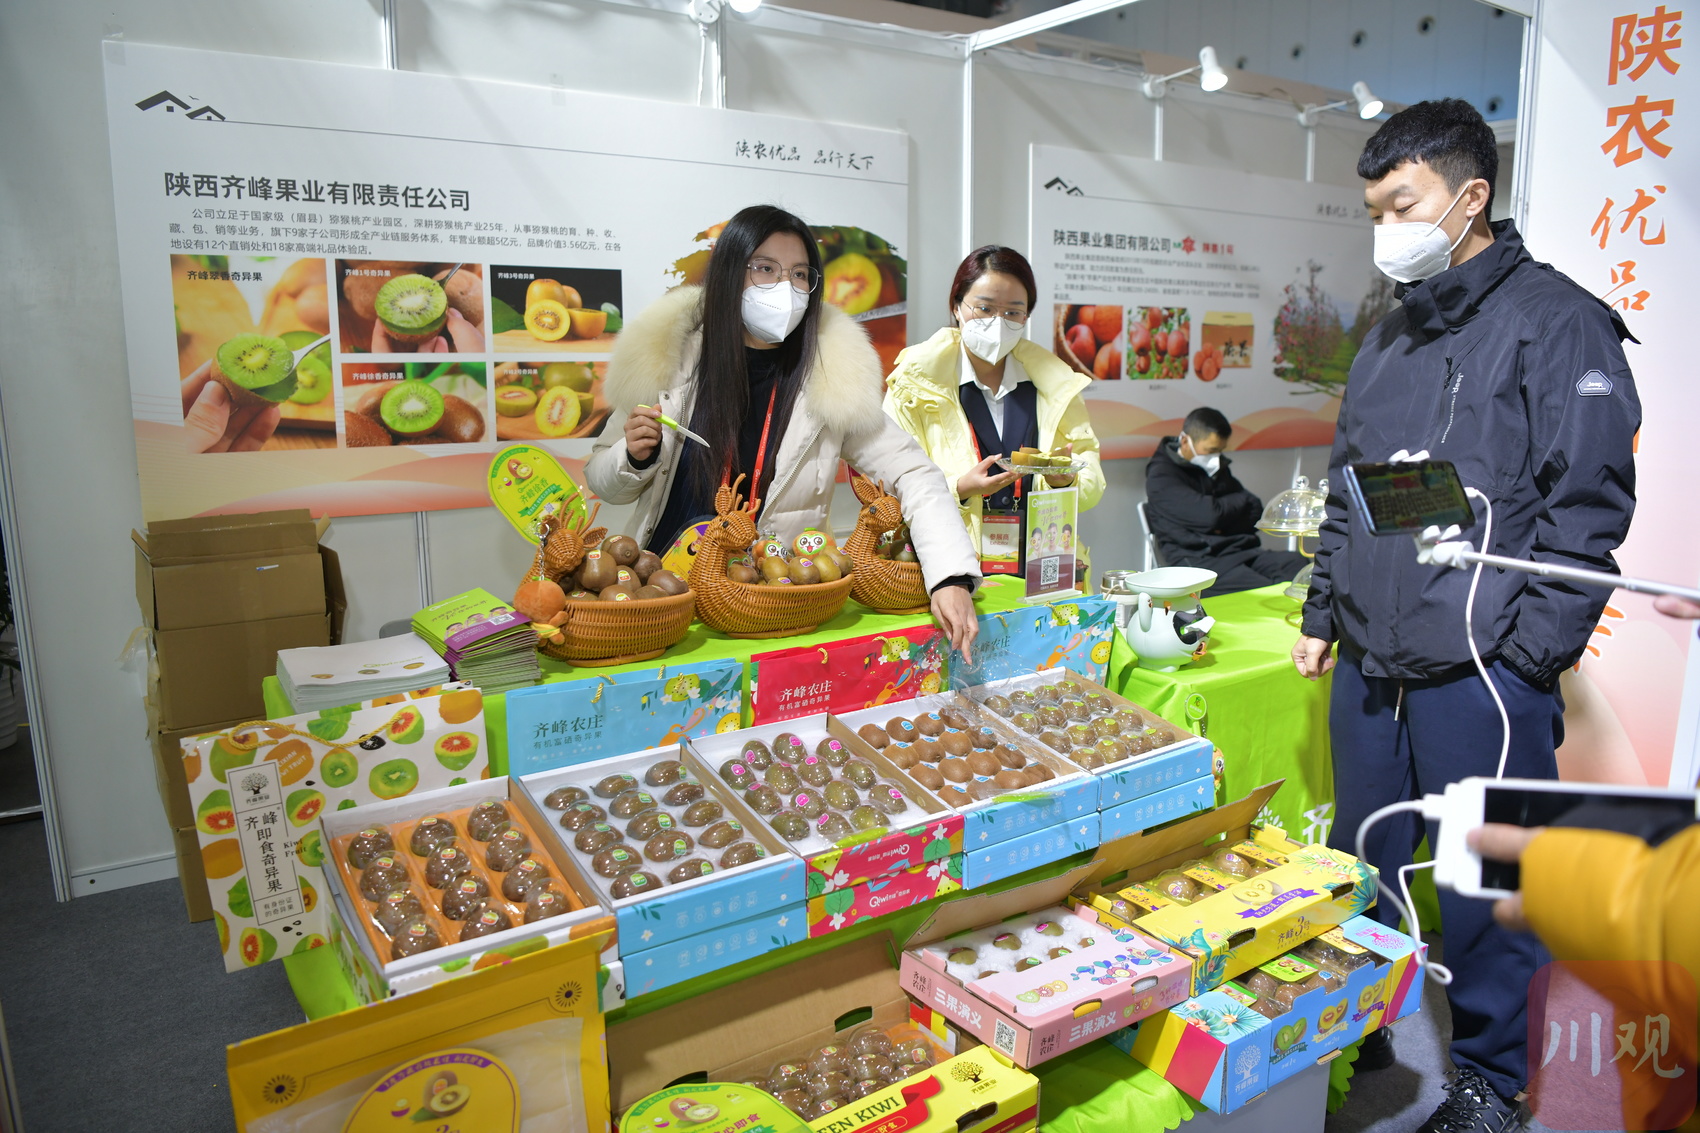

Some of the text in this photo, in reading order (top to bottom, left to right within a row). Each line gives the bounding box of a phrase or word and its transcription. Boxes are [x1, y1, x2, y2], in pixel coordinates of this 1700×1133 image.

[1591, 5, 1682, 311] 陕农优品
[163, 171, 471, 211] 陕西齐峰果业有限责任公司
[1053, 229, 1172, 253] 陕西果业集团有限公司
[187, 270, 263, 282] 齐峰翠香奇异果
[345, 268, 391, 277] 齐峰1号奇异果
[352, 371, 404, 381] 齐峰徐香奇异果
[1452, 372, 1465, 394] Jeep
[1587, 381, 1603, 389] Jeep
[989, 533, 1010, 541] 参展商
[780, 680, 832, 702] 齐峰农庄
[533, 714, 603, 739] 齐峰农庄
[533, 731, 602, 749] 有机富硒奇异果
[283, 838, 303, 849] Kiwi
[284, 846, 307, 857] Fruit
[934, 987, 982, 1029] 三果演义
[1068, 1011, 1117, 1042] 三果演义
[857, 1096, 901, 1124] KIWI
